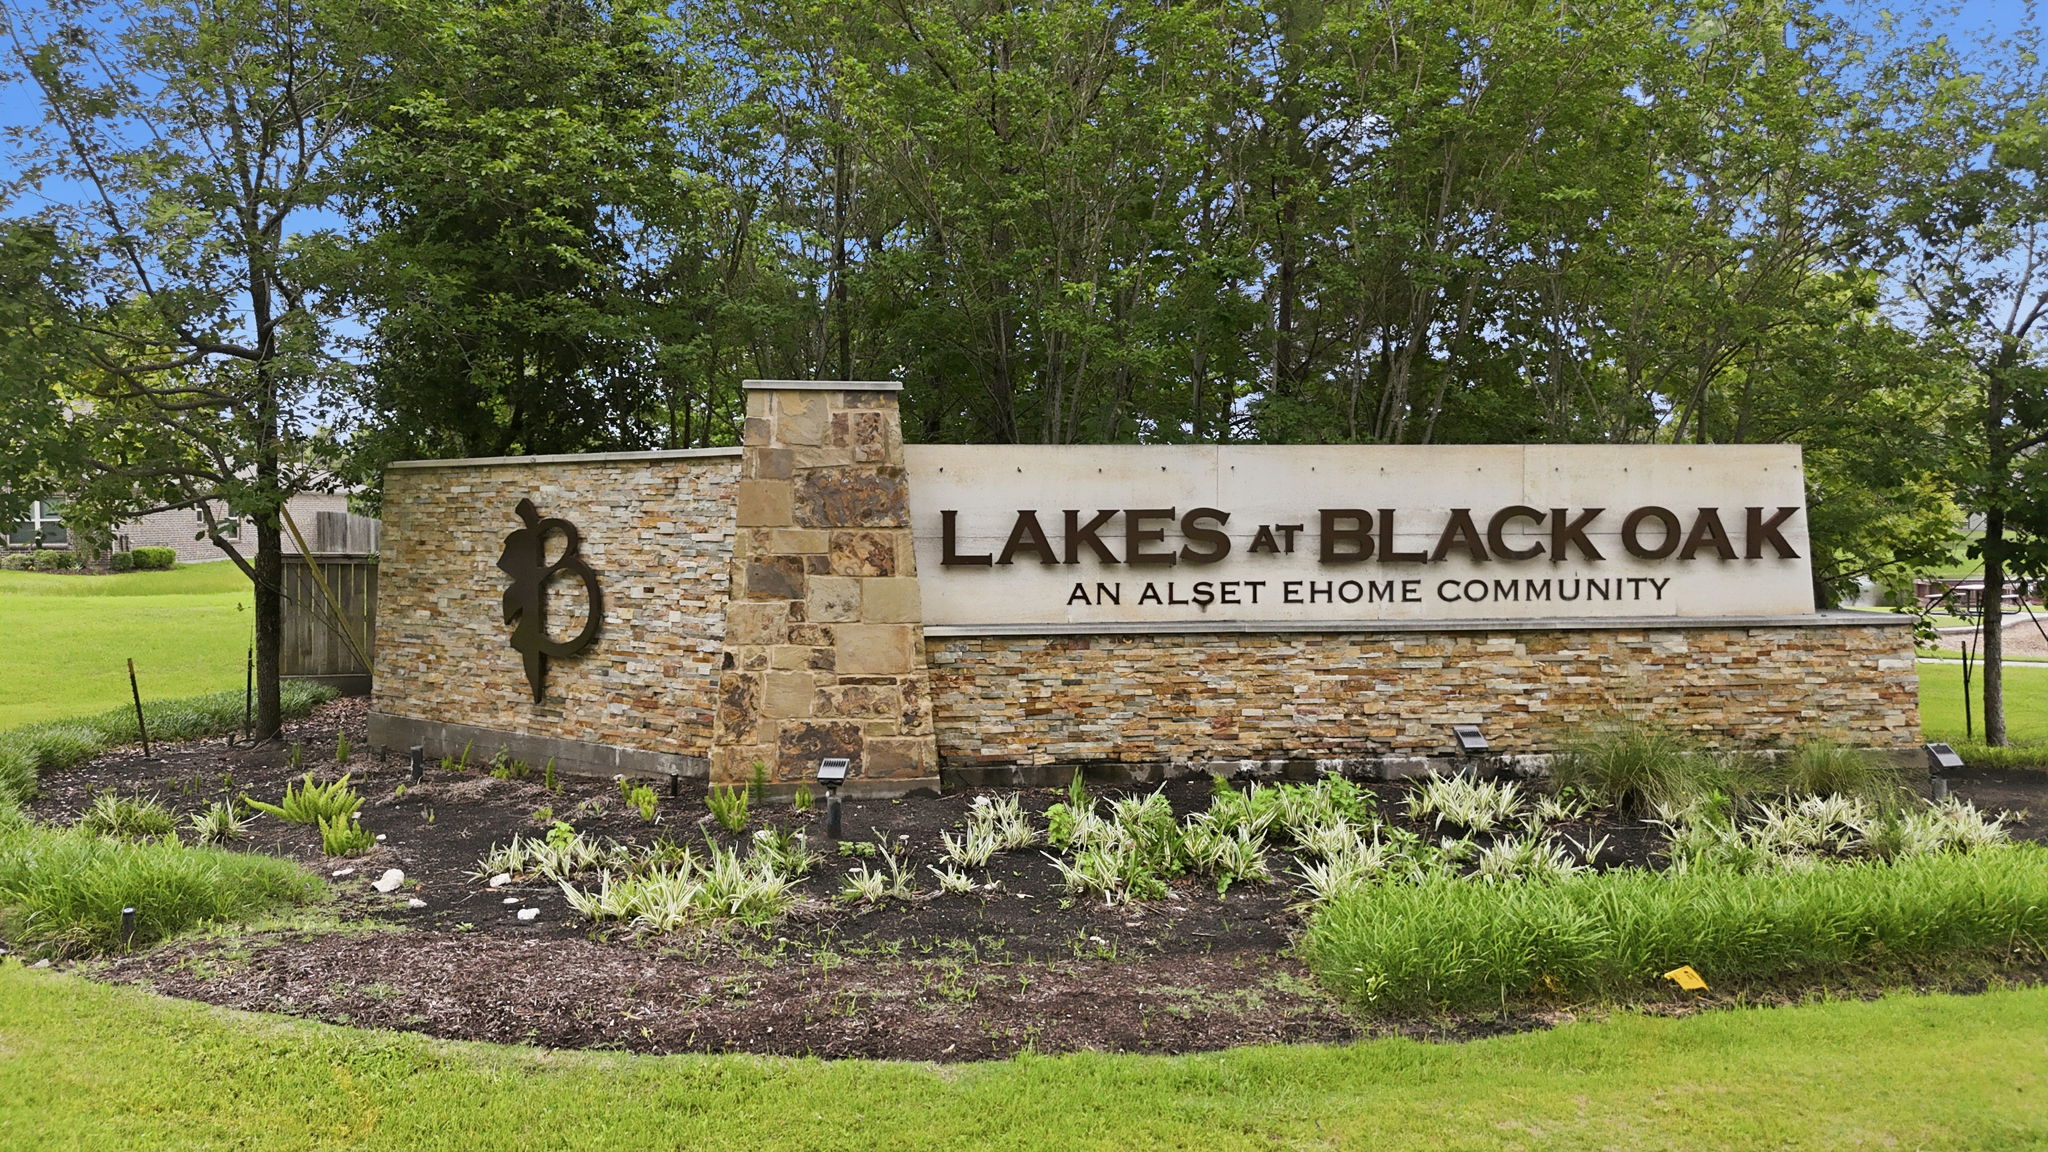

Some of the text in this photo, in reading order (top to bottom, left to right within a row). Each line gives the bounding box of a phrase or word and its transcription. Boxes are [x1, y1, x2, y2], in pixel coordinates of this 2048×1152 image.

[940, 505, 1801, 567] LAKES AT BLACK OAK
[1066, 577, 1671, 606] AN ALSET EHOME COMMUNITY
